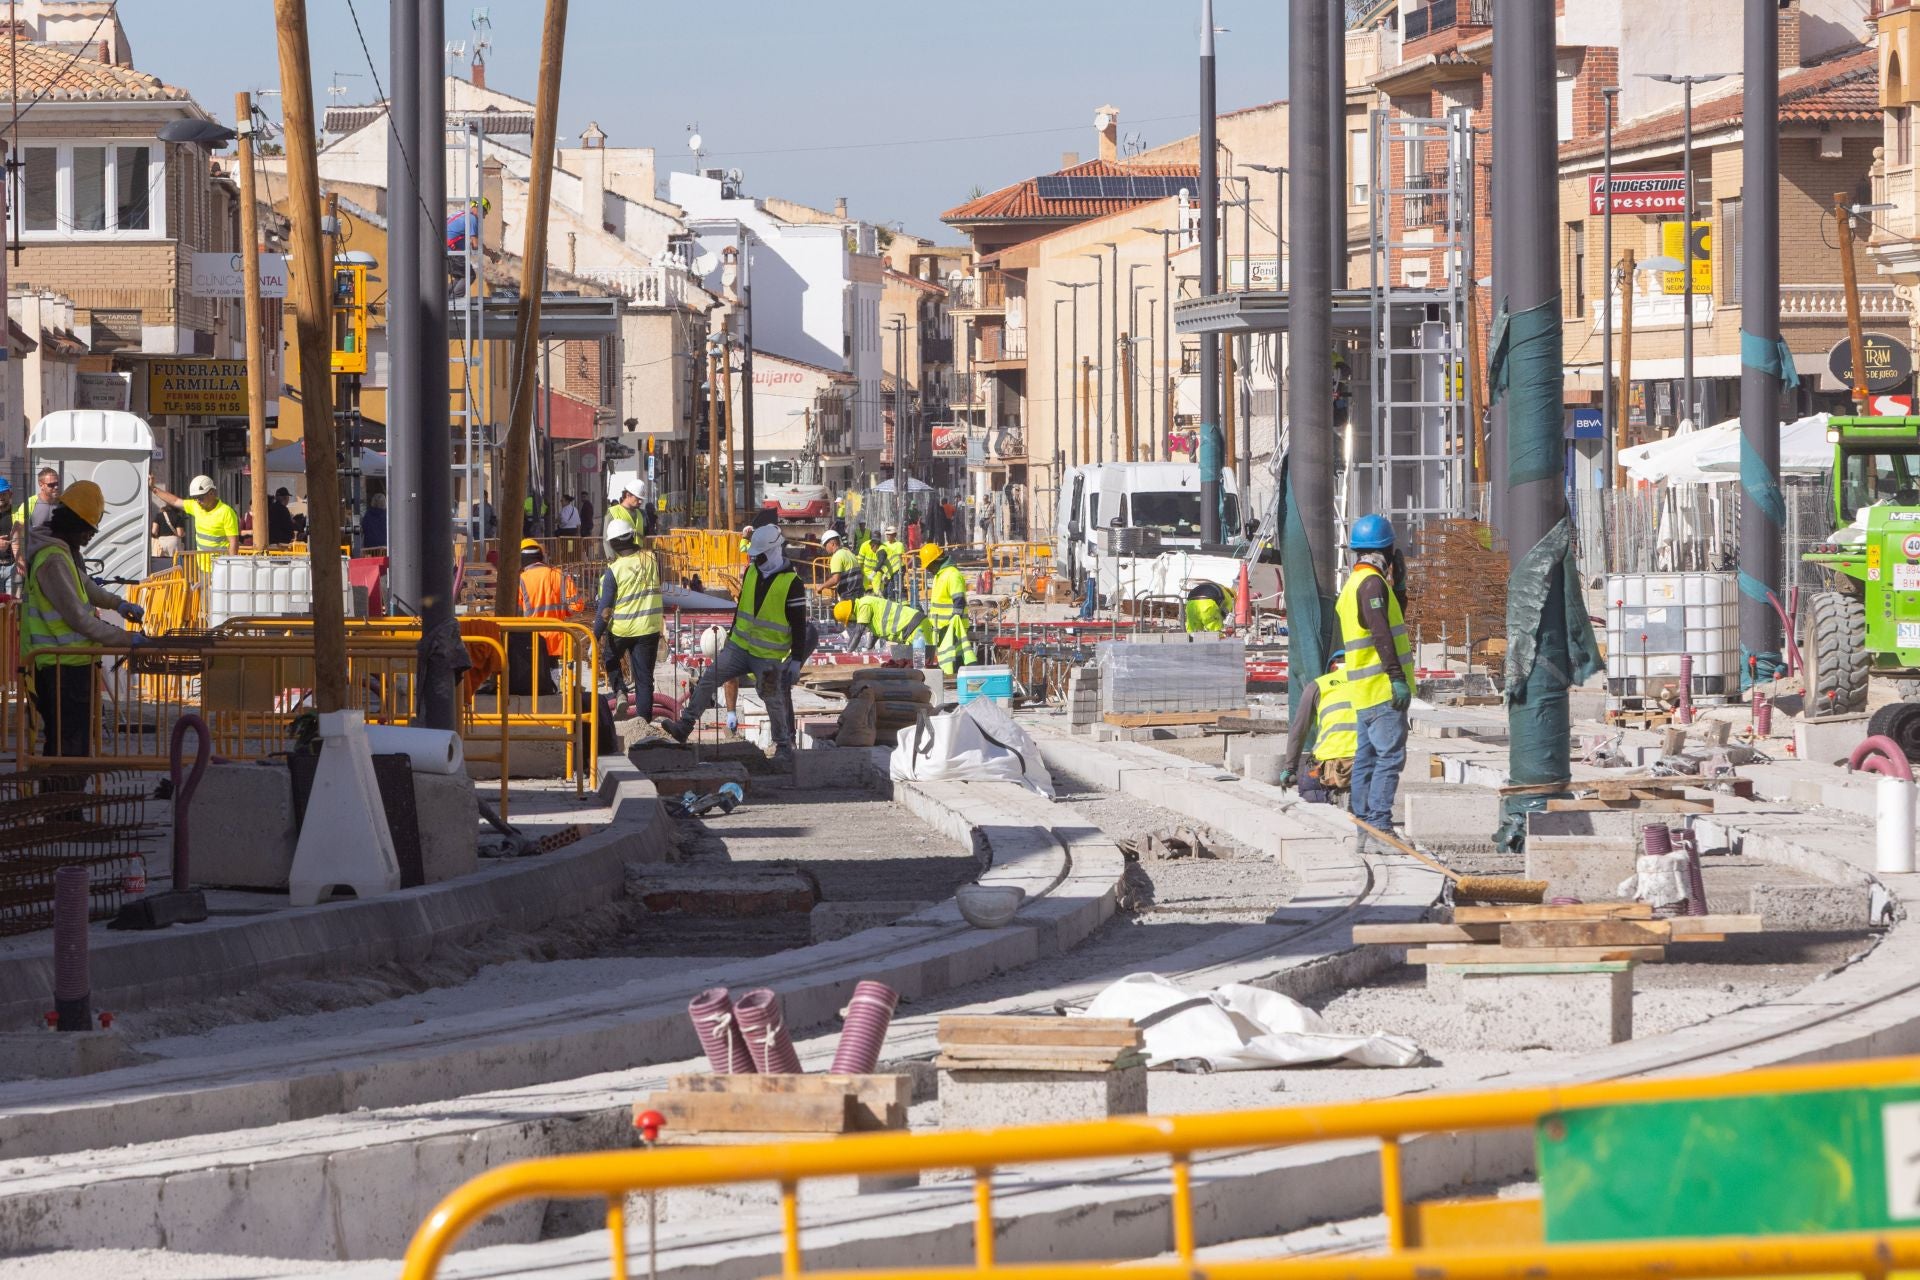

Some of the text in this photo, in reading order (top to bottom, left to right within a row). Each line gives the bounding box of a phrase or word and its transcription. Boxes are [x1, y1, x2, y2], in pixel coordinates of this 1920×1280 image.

[1594, 196, 1685, 211] Frestone
[259, 276, 283, 286] NTAL
[154, 364, 248, 376] FUNERARIA
[1871, 370, 1879, 378] DE
[1879, 369, 1898, 380] JUEGO
[163, 379, 240, 391] ARMILLA
[185, 402, 201, 411] 958
[205, 402, 216, 411] 55
[219, 402, 226, 411] 11
[228, 402, 240, 411] 55
[1576, 419, 1602, 428] BBVA
[1908, 540, 1920, 551] 40
